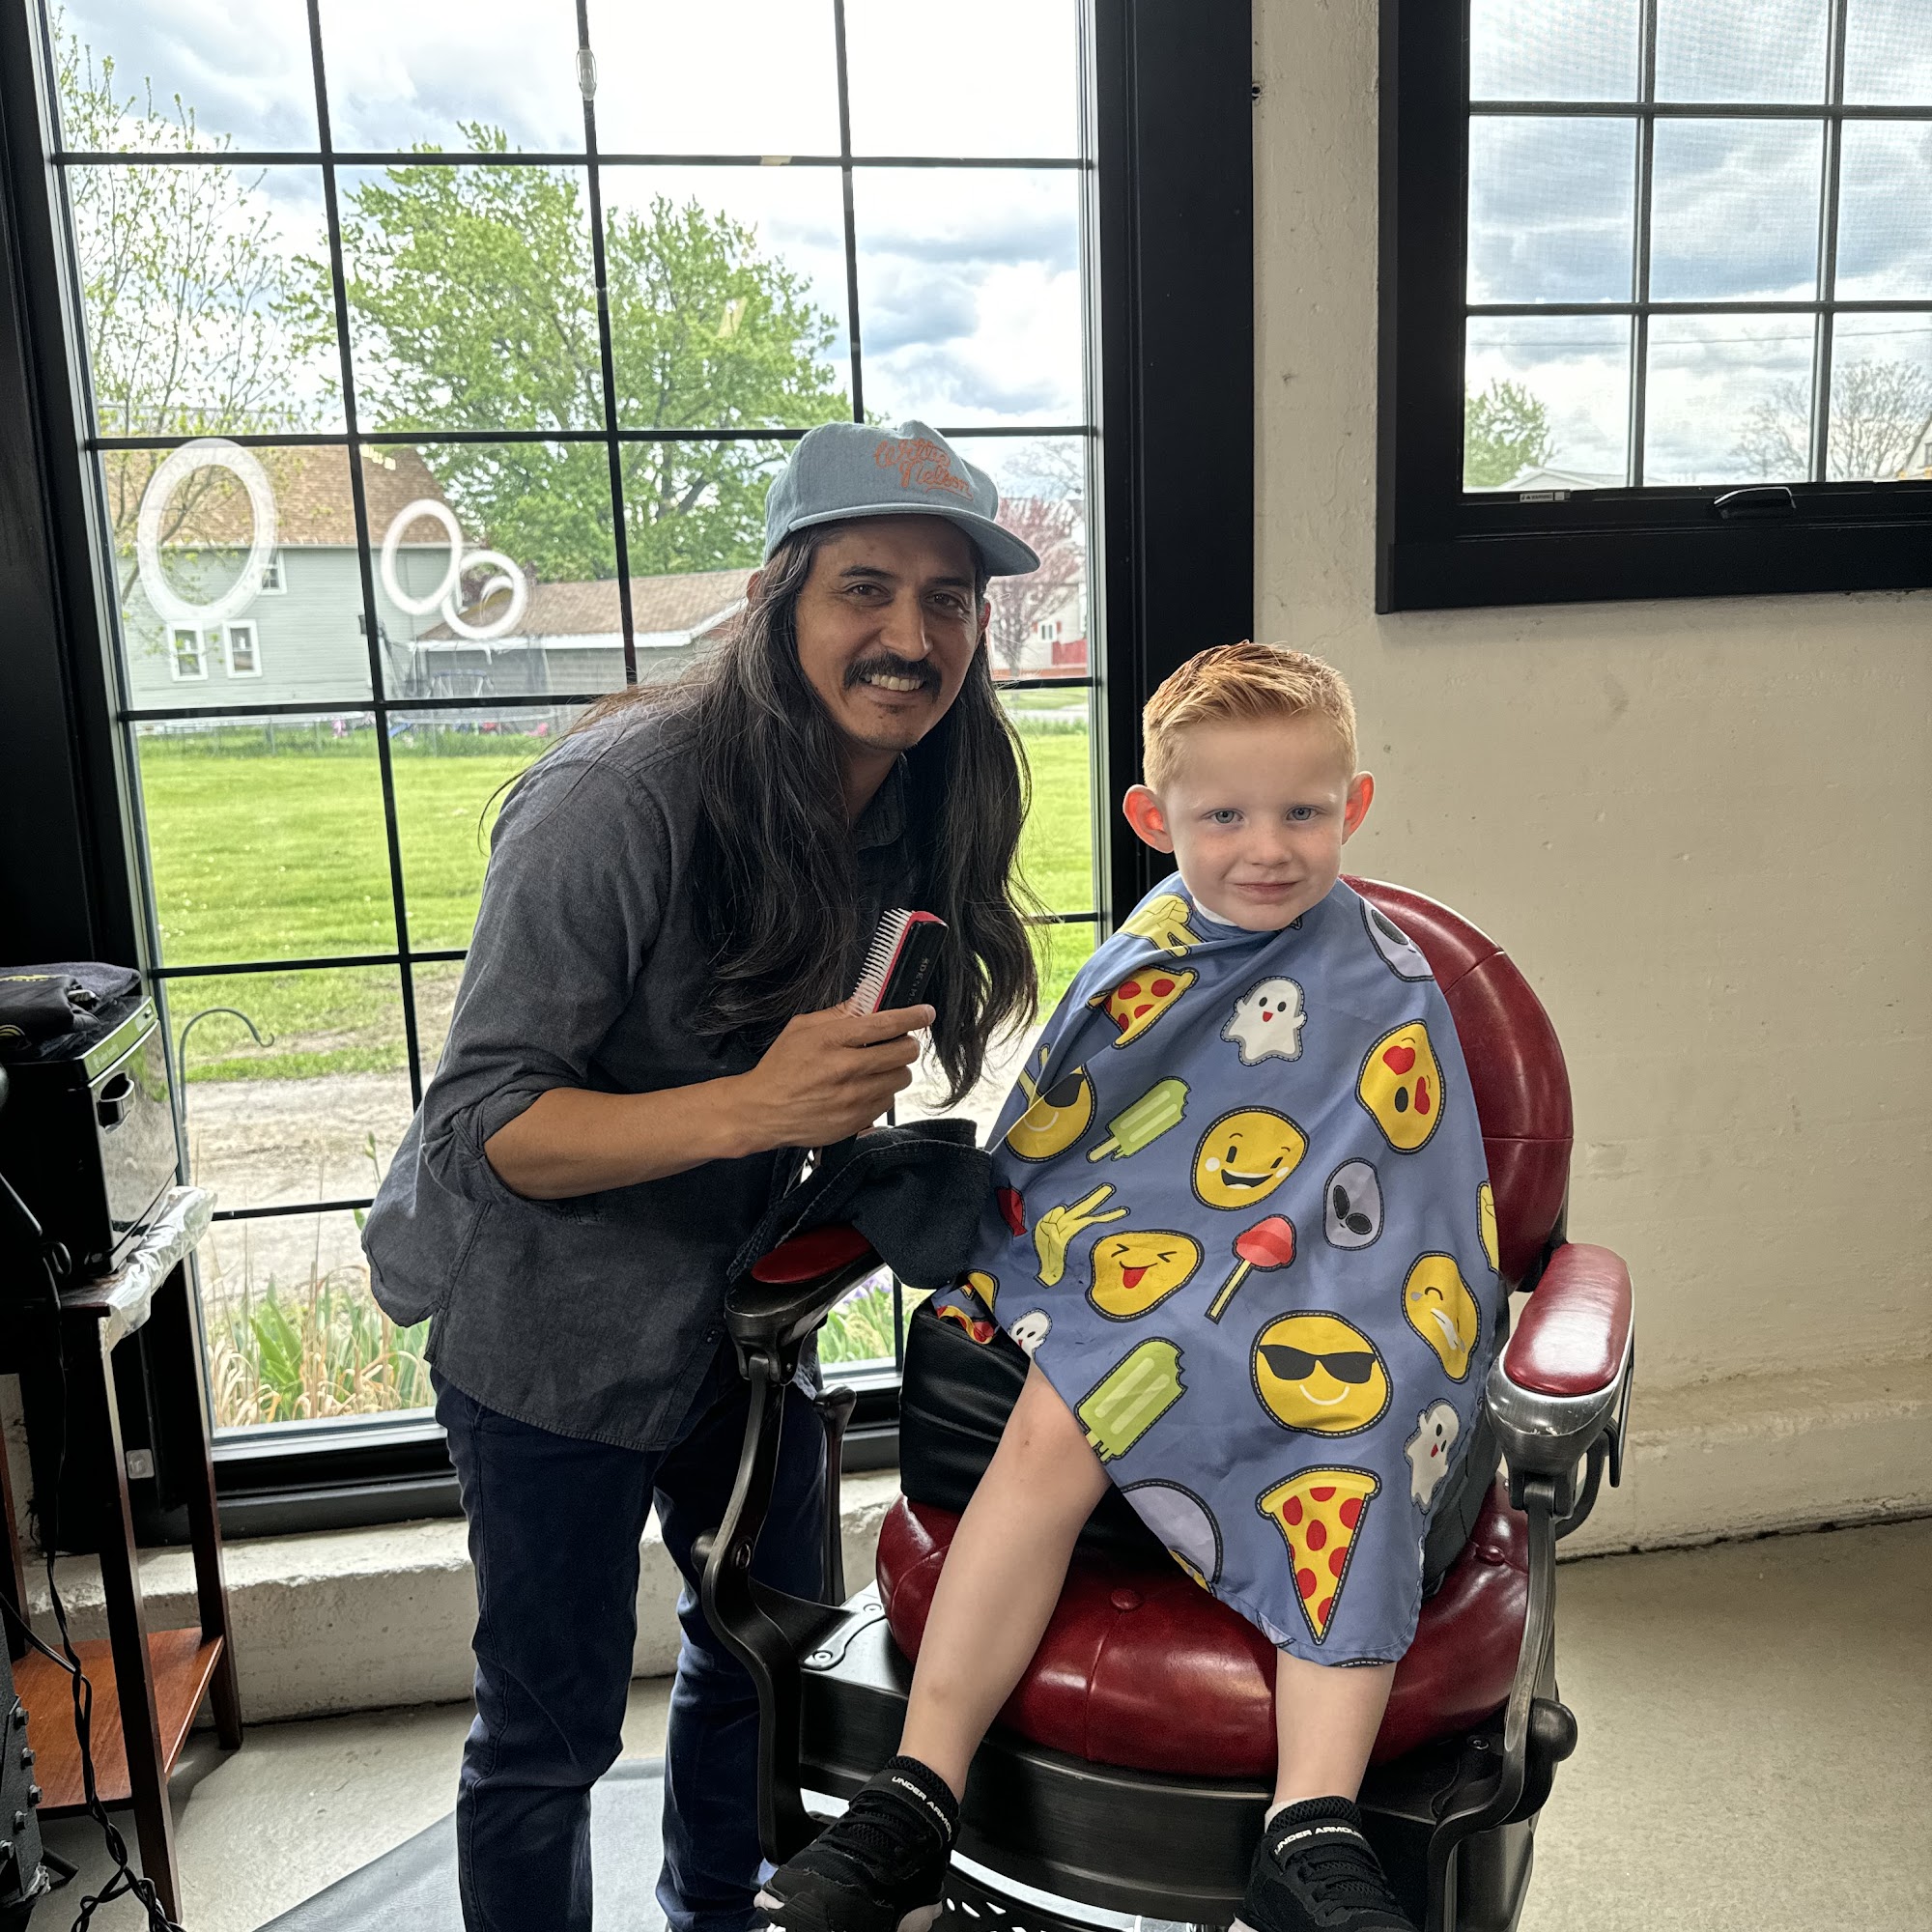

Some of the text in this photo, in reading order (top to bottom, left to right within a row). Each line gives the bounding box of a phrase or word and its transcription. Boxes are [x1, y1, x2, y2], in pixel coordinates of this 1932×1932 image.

[899, 460, 974, 501] Nelson
[892, 1776, 927, 1801] UNDER
[1274, 1830, 1313, 1855] UNDER
